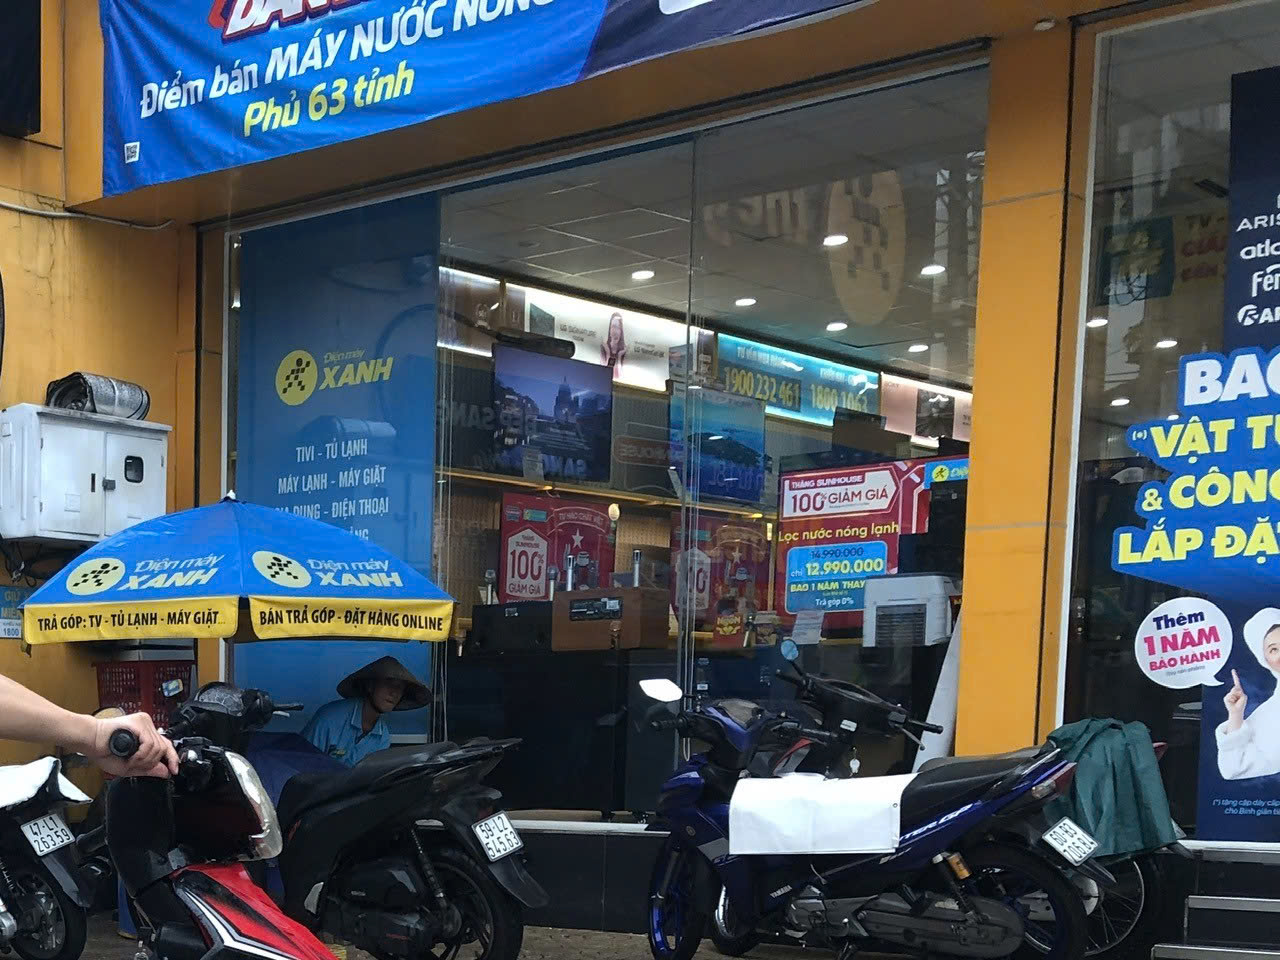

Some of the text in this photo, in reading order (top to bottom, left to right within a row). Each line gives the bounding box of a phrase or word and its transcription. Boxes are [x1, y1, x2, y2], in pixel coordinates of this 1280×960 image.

[140, 70, 205, 119] Điểm
[209, 58, 258, 99] bán
[265, 28, 347, 84] MÁY
[244, 60, 415, 137] Phủ 63 tỉnh
[319, 356, 394, 390] XANH
[296, 437, 367, 462] TIVI TỦ LẠNH
[278, 464, 386, 494] MÁY LẠNH MÁY GIẶT
[828, 488, 862, 504] GIẢM
[865, 485, 888, 501] GIÁ
[1141, 488, 1163, 511] &
[331, 498, 355, 520] ĐIỆN
[359, 496, 389, 517] THOẠI
[778, 521, 899, 544] Lọc nước nóng lạnh
[1118, 516, 1280, 565] LẮP ĐẶ
[118, 567, 218, 591] XANH
[318, 571, 403, 587] XANH
[805, 558, 884, 576] 12.990.000
[842, 580, 866, 589] THAY
[38, 613, 57, 631] TRẢ
[88, 614, 102, 628] TV
[111, 609, 125, 627] TỦ
[128, 611, 158, 630] LẠNH
[167, 609, 191, 625] MÁY
[260, 605, 443, 631] BÁN TRẢ GÓP ĐẶT HÀNG ONLINE
[1152, 611, 1205, 631] Thêm
[1143, 625, 1221, 656] 1 NĂM
[1149, 656, 1178, 671] BẢO
[33, 828, 71, 852] 263.59
[484, 831, 520, 858] 545.63
